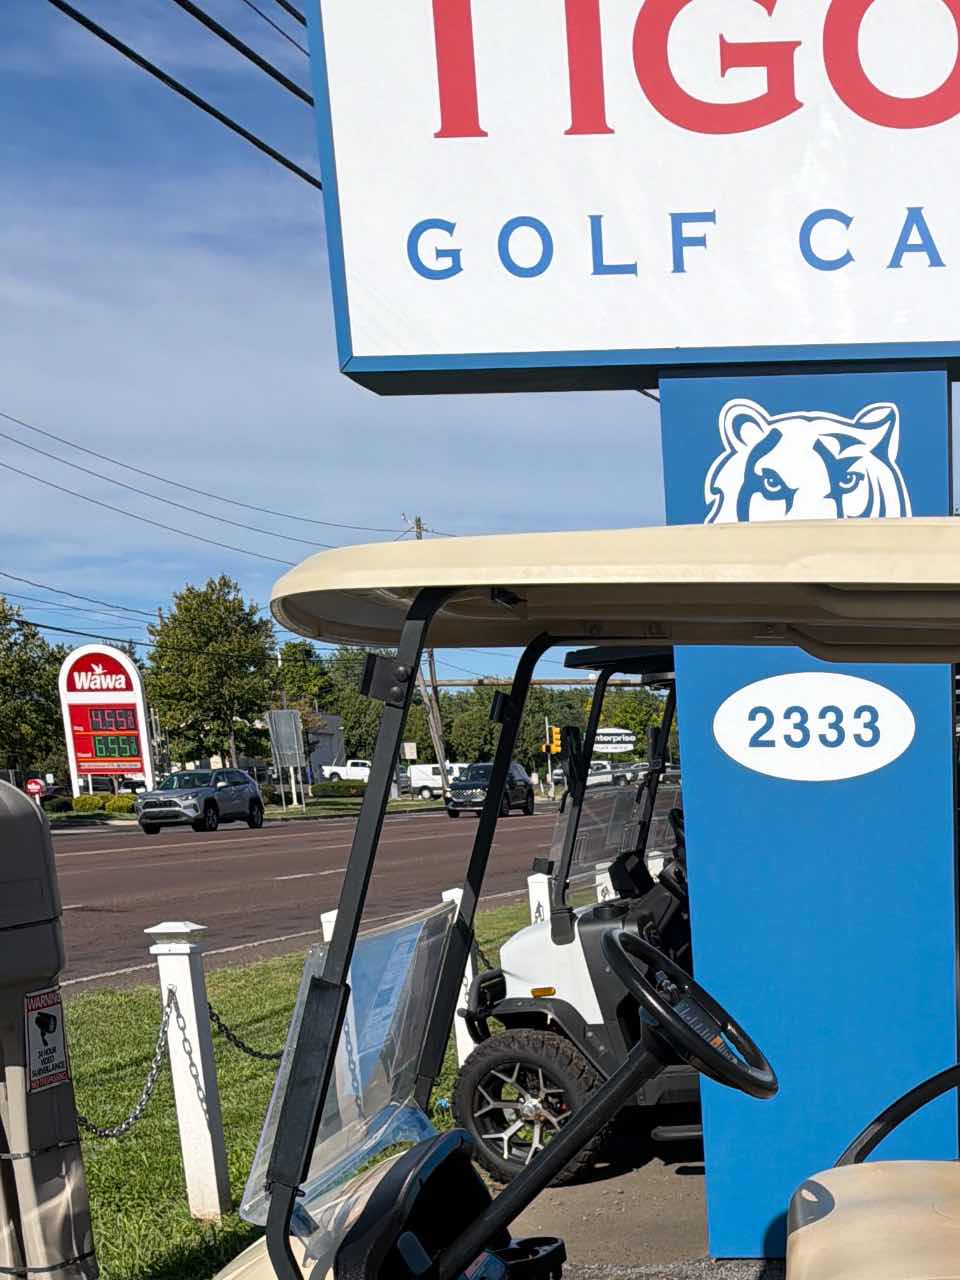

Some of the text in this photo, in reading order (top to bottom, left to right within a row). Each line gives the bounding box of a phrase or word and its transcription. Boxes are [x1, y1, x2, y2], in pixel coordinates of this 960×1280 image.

[406, 211, 717, 281] GOLF
[73, 671, 126, 690] Wawa
[747, 704, 881, 749] 2333
